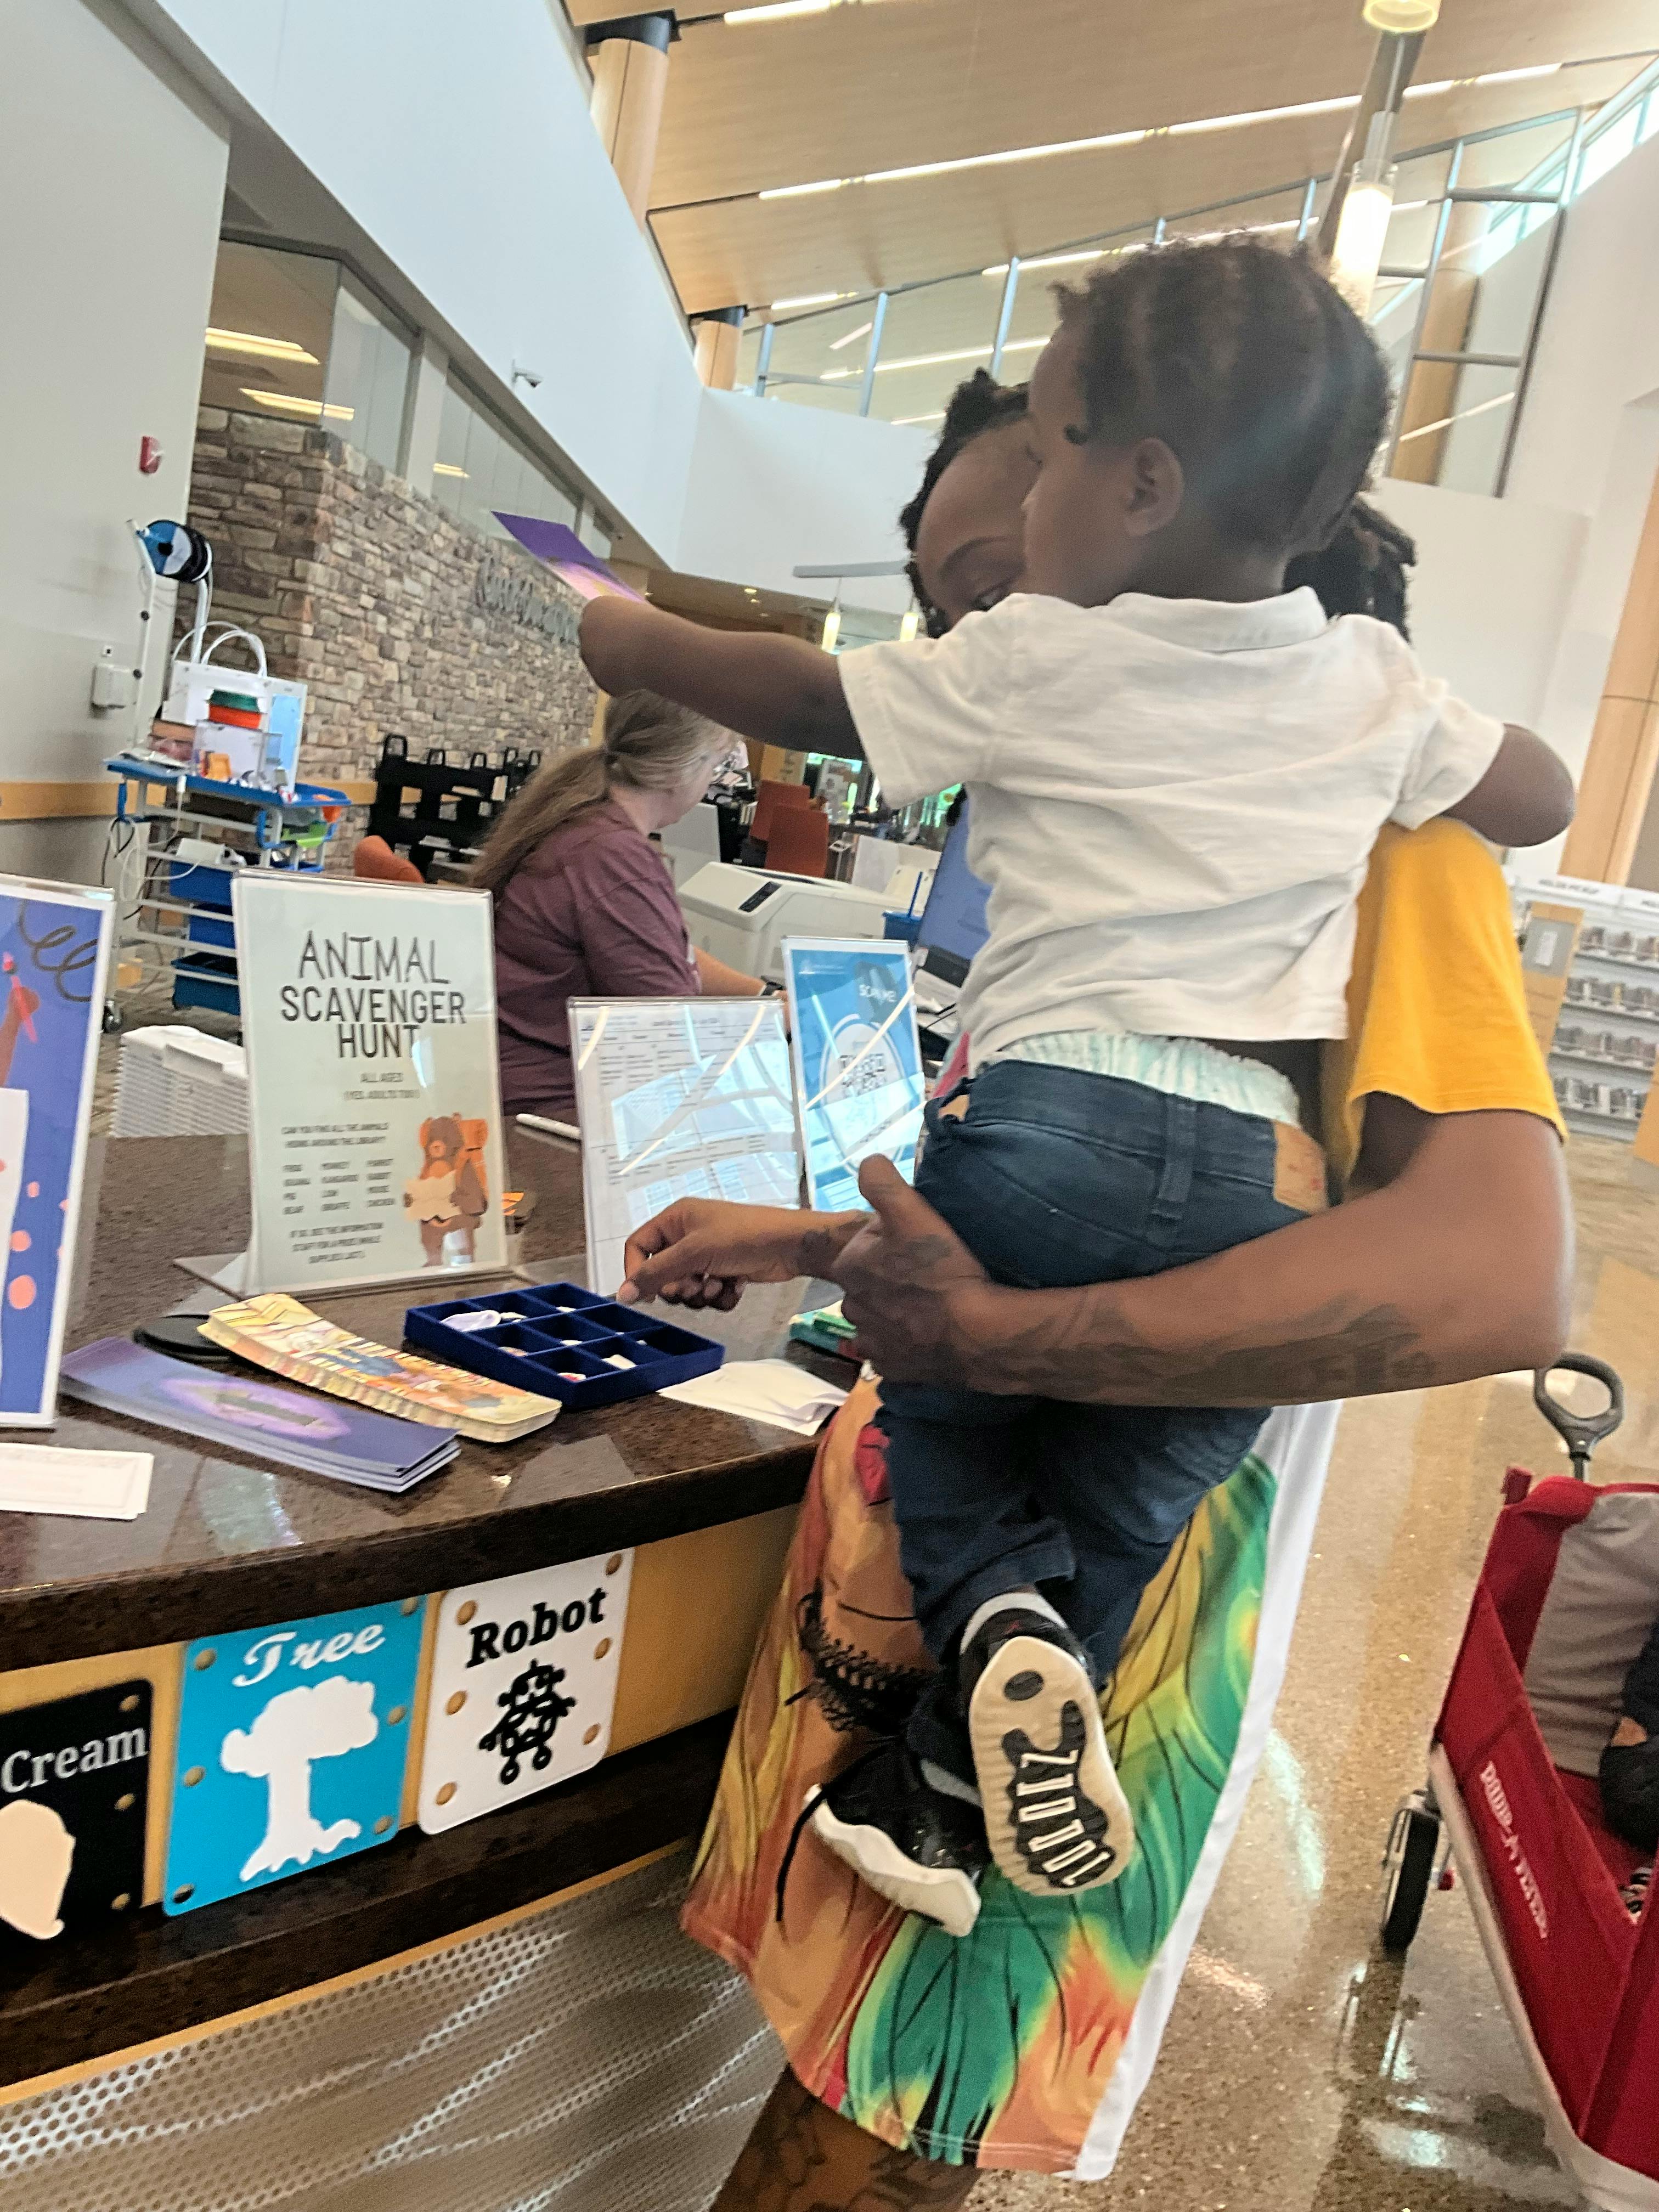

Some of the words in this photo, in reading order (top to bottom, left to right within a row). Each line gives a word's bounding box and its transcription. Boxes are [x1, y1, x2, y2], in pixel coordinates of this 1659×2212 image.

[298, 930, 451, 984] ANIMAL
[280, 985, 468, 1024] SCAVENGER
[337, 1024, 421, 1058] HUNT
[231, 1624, 386, 1688] Tree
[466, 1587, 607, 1668] Robot
[1, 1726, 150, 1793] Cream
